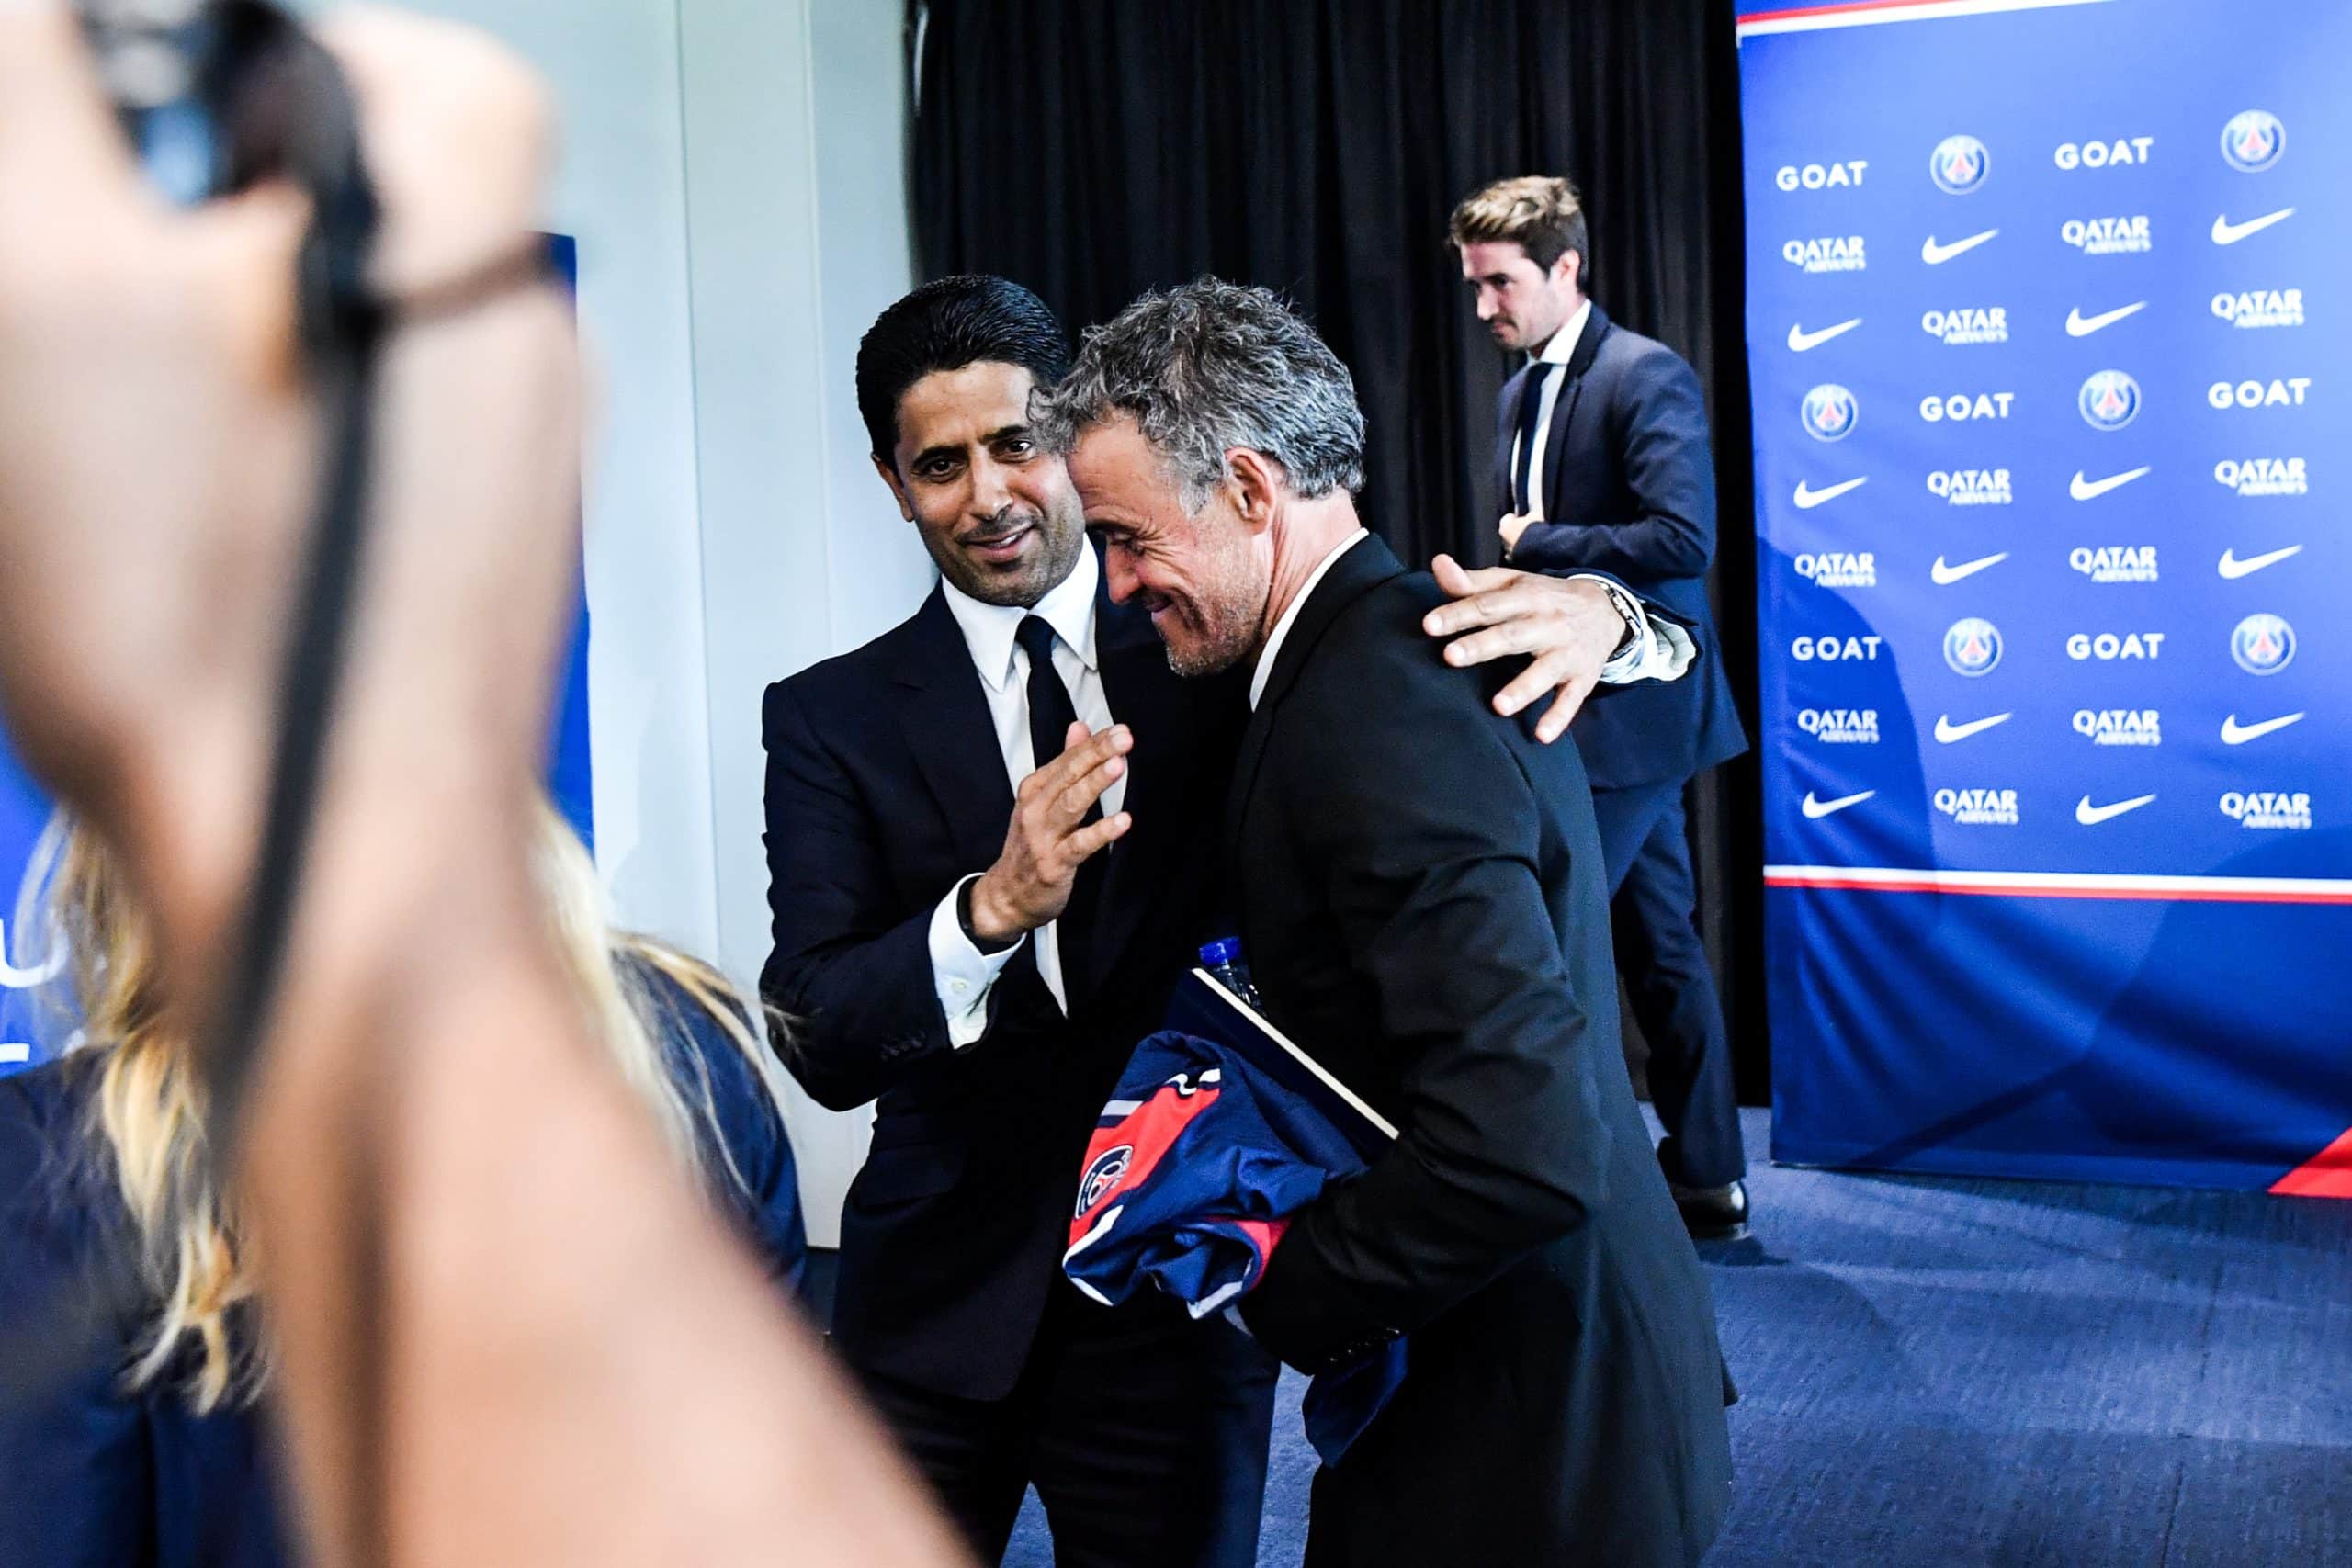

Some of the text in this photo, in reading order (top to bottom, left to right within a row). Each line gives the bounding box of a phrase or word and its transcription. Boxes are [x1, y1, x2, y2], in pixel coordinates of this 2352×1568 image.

[2055, 137, 2154, 170] GOAT
[1776, 161, 1867, 191] GOAT
[2062, 216, 2149, 247] QATAR
[1783, 236, 1864, 265] QATAR
[2211, 289, 2302, 321] QATAR
[1922, 308, 2006, 337] QATAR
[1920, 393, 2014, 422] GOAT
[2208, 378, 2311, 409] GOAT
[1928, 469, 2010, 498] QATAR
[2215, 458, 2305, 488] QATAR
[1794, 553, 1874, 580] QATAR
[2070, 547, 2156, 574] QATAR
[1792, 637, 1880, 660] GOAT
[2066, 633, 2164, 660] GOAT
[1798, 709, 1877, 735] QATAR
[2073, 710, 2159, 737] QATAR
[1934, 789, 2017, 815] QATAR
[2219, 792, 2310, 819] QATAR
